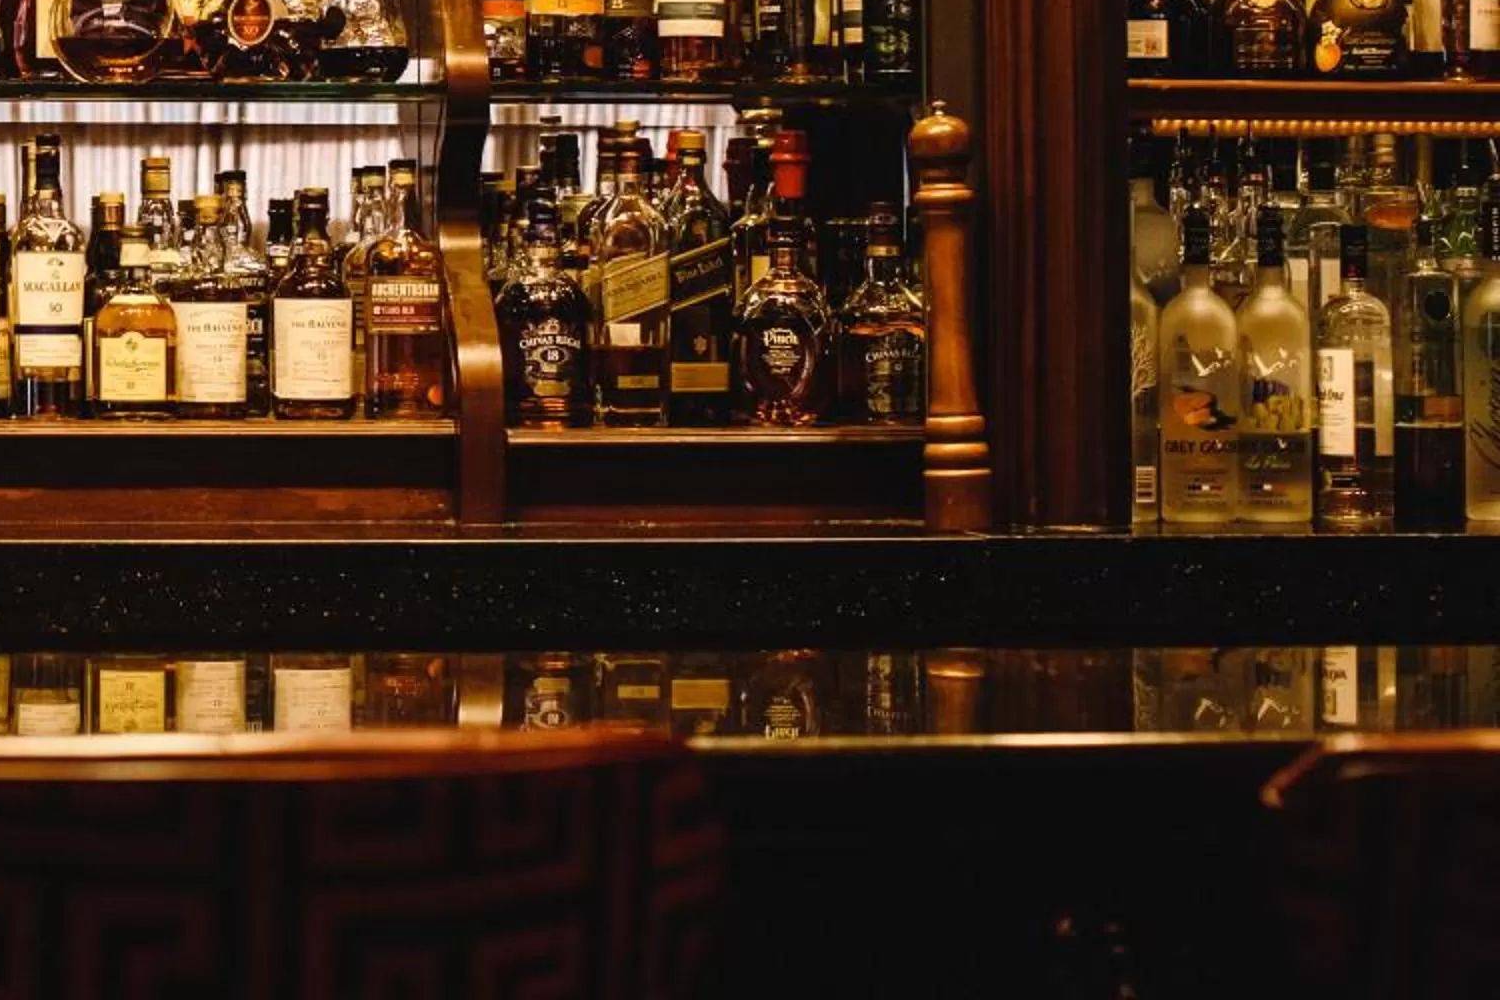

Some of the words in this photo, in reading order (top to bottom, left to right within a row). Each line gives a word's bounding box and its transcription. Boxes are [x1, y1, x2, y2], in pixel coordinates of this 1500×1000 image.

[22, 281, 82, 293] MACALLAN
[763, 331, 799, 347] Pinch
[546, 350, 560, 361] 18
